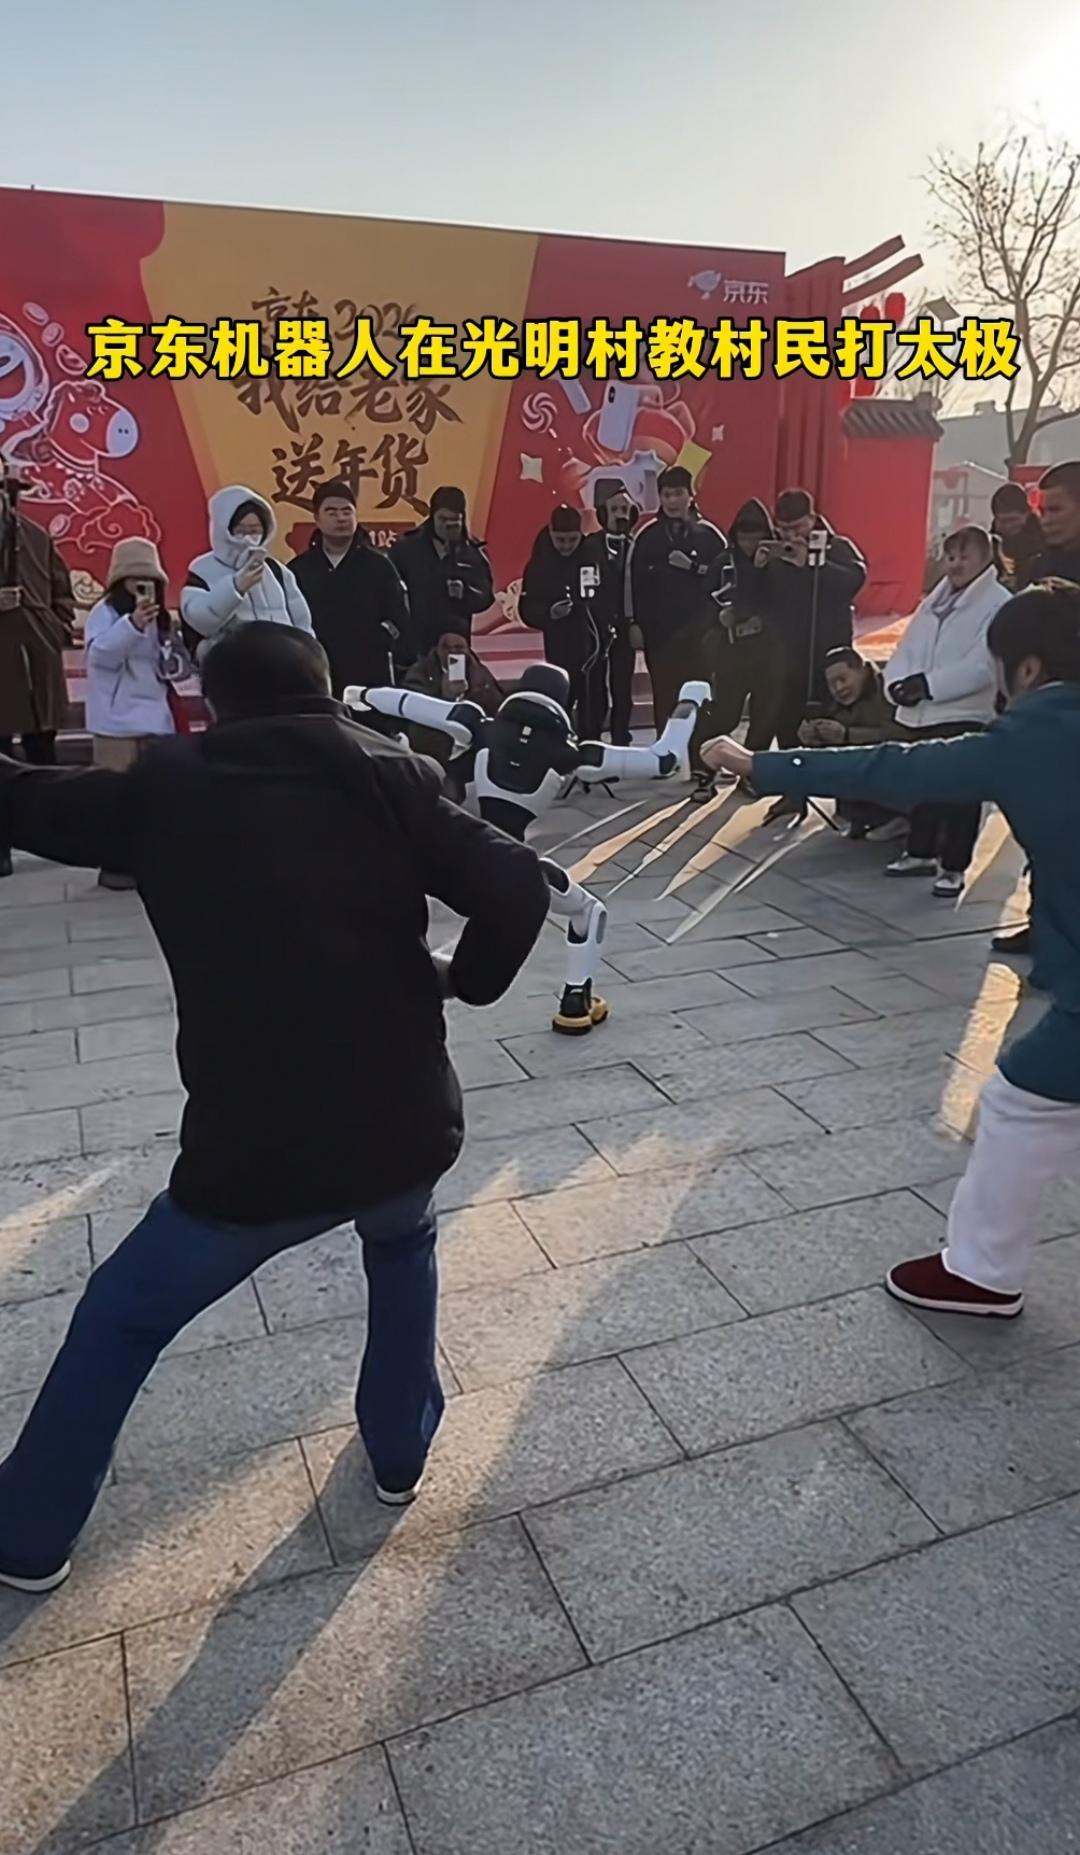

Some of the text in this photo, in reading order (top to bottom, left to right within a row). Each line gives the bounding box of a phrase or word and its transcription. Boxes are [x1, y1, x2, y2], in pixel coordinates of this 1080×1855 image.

[723, 280, 769, 304] 京东
[271, 432, 431, 518] 送年货
